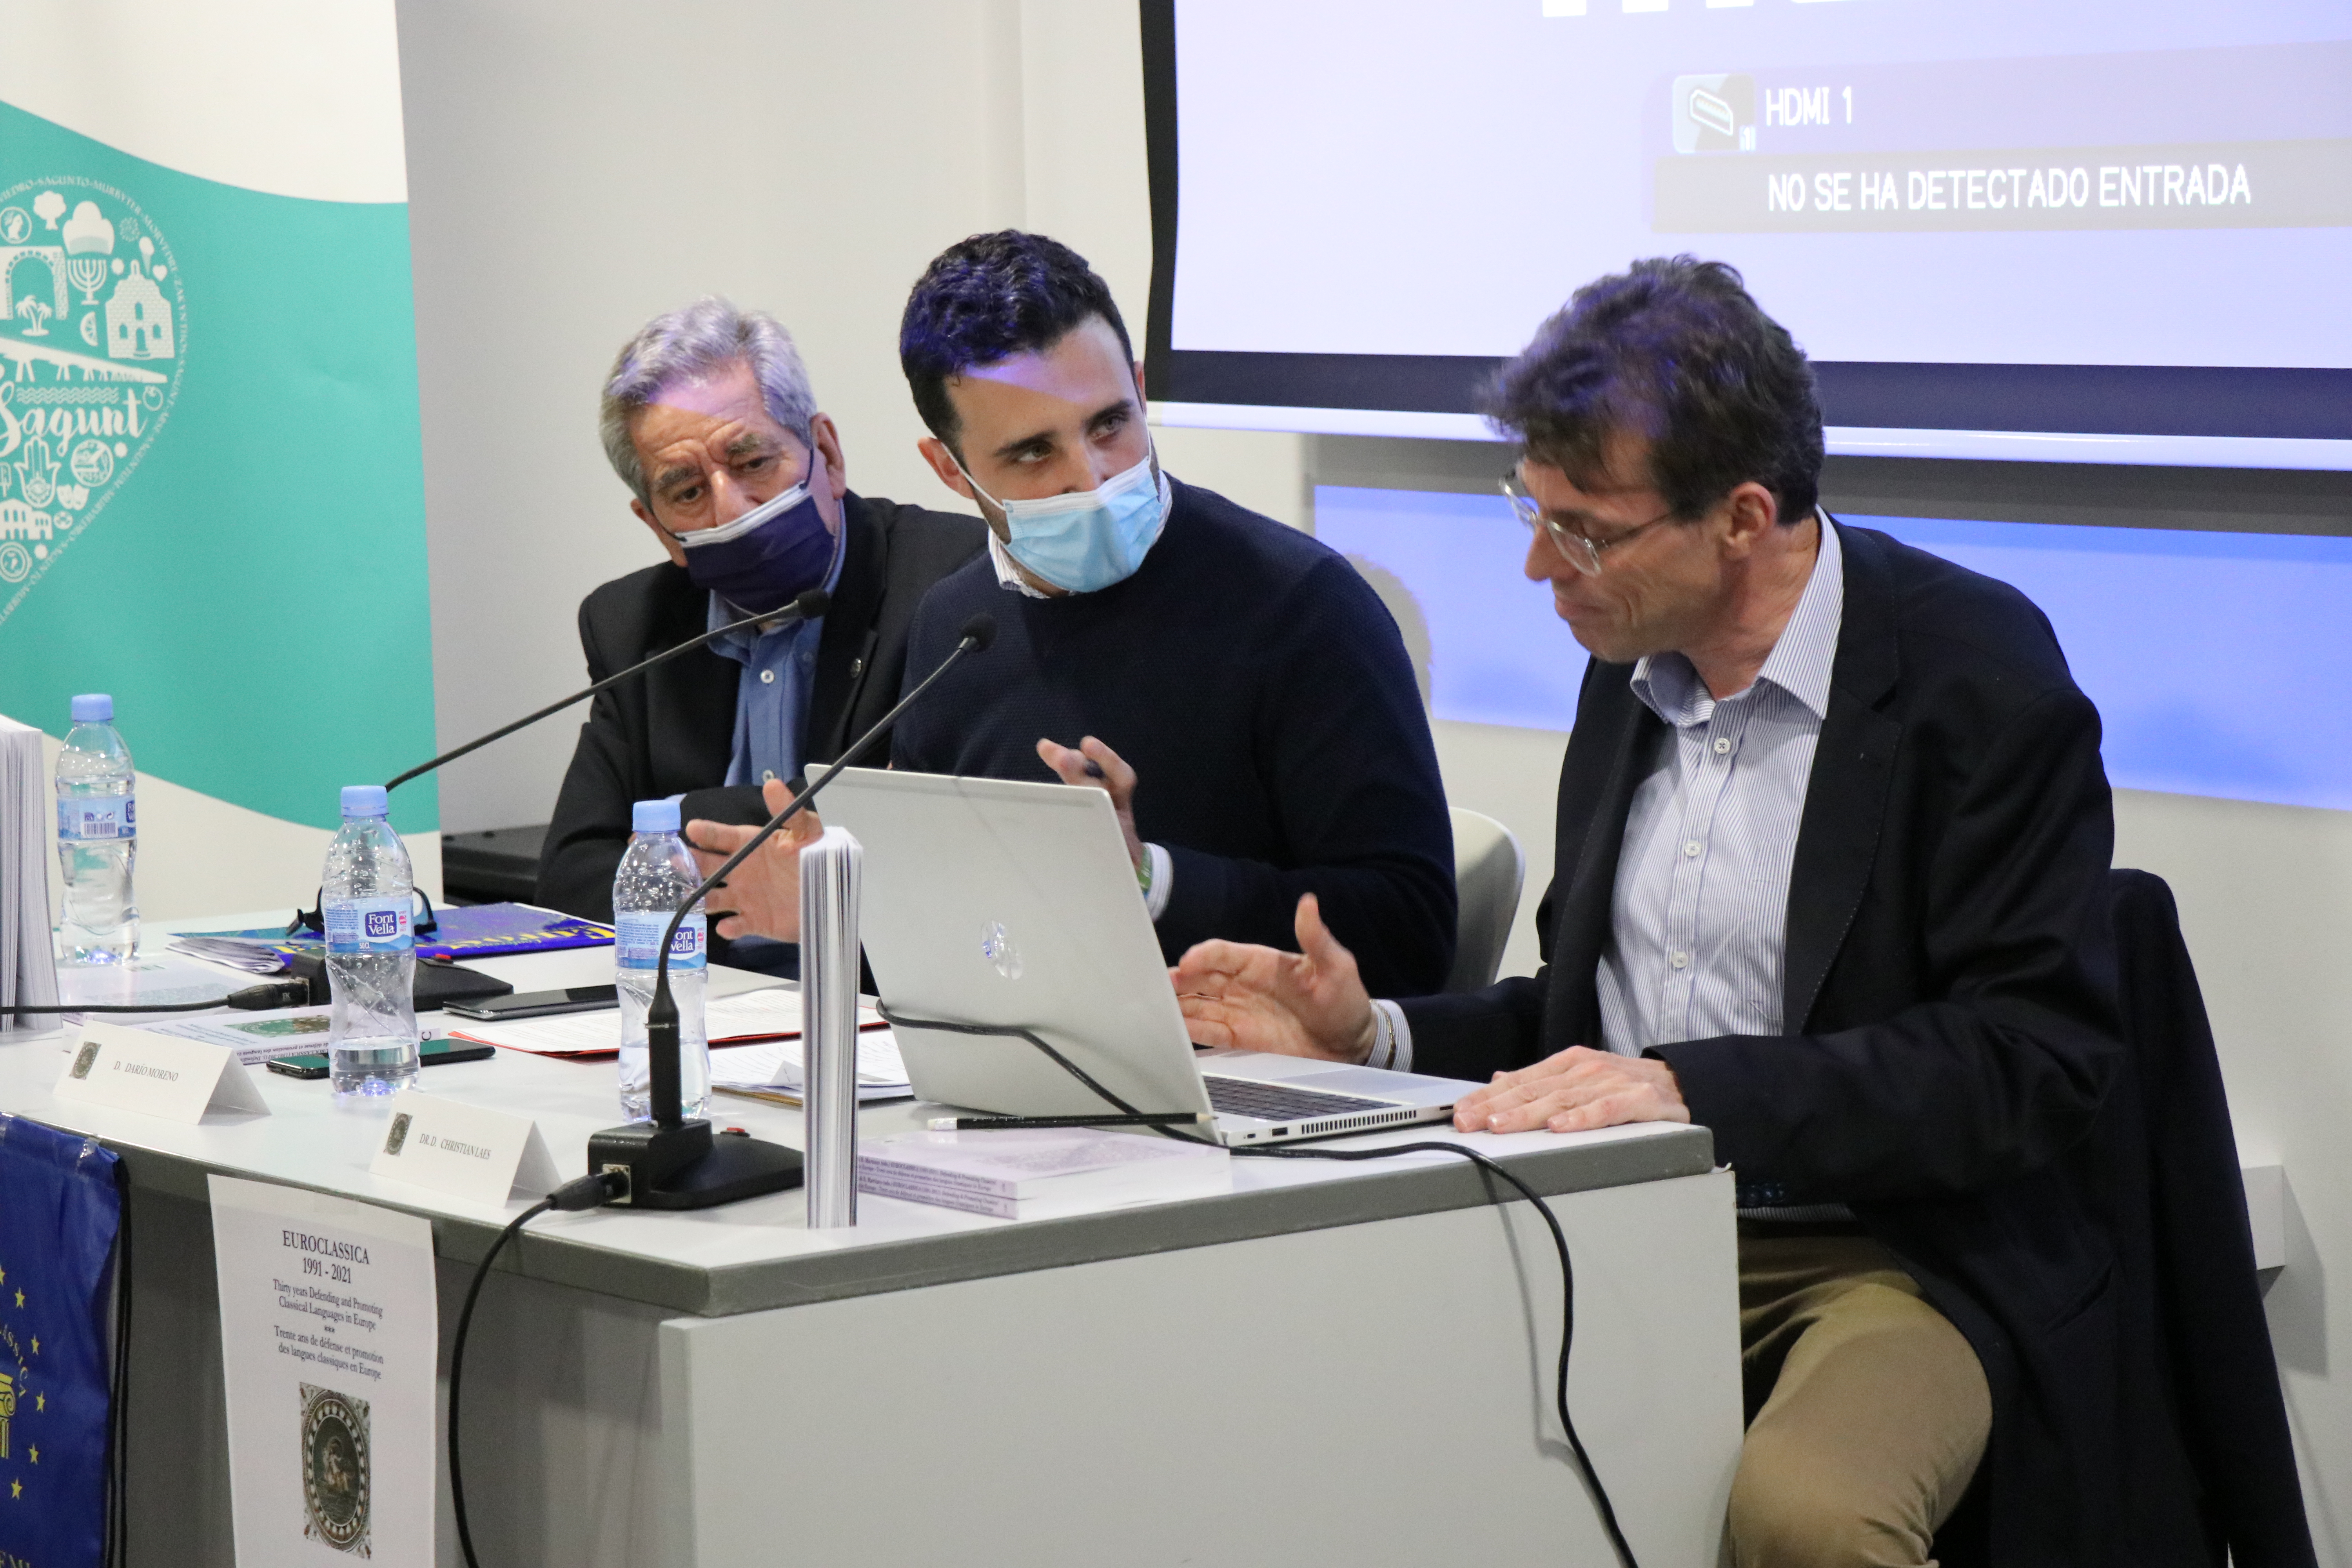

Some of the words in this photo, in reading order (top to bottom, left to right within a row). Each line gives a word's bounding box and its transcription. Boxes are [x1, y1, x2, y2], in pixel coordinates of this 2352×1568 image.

[1765, 87, 1830, 126] HDMI
[1842, 85, 1852, 124] 1
[38, 175, 90, 187] SAGUNTO
[1768, 173, 1805, 211] NO
[1814, 172, 1851, 211] SE
[1861, 172, 1898, 209] HA
[1908, 167, 2089, 209] DETECTADO
[2099, 163, 2251, 207] ENTRADA
[0, 380, 148, 457] Sagunt
[368, 914, 395, 924] Font
[368, 923, 396, 935] Vella
[675, 930, 693, 940] ont
[114, 1061, 120, 1071] D.
[125, 1063, 148, 1076] DARÍO
[147, 1067, 178, 1082] MORENO
[441, 1139, 475, 1156] CHRISTIAN
[474, 1147, 491, 1160] LAES
[282, 1230, 370, 1265] EUROCLASSICA
[303, 1257, 322, 1277] 1991
[332, 1264, 352, 1284] 2021
[273, 1278, 290, 1297] Thirty
[293, 1287, 308, 1298] years
[309, 1287, 340, 1308] Defending
[341, 1297, 352, 1308] and
[353, 1297, 383, 1319] Promoting
[279, 1296, 308, 1312] Classical
[309, 1303, 344, 1323] Languages
[346, 1311, 352, 1323] in
[354, 1313, 377, 1332] Europe
[0, 1323, 28, 1397] ASSICA
[274, 1325, 296, 1341] Trente
[298, 1334, 309, 1344] ans
[310, 1335, 318, 1346] de
[352, 1348, 384, 1364] promotion
[279, 1343, 289, 1354] des
[291, 1345, 316, 1362] langues
[317, 1352, 349, 1371] classiques
[350, 1363, 358, 1373] en
[359, 1362, 381, 1382] Europe
